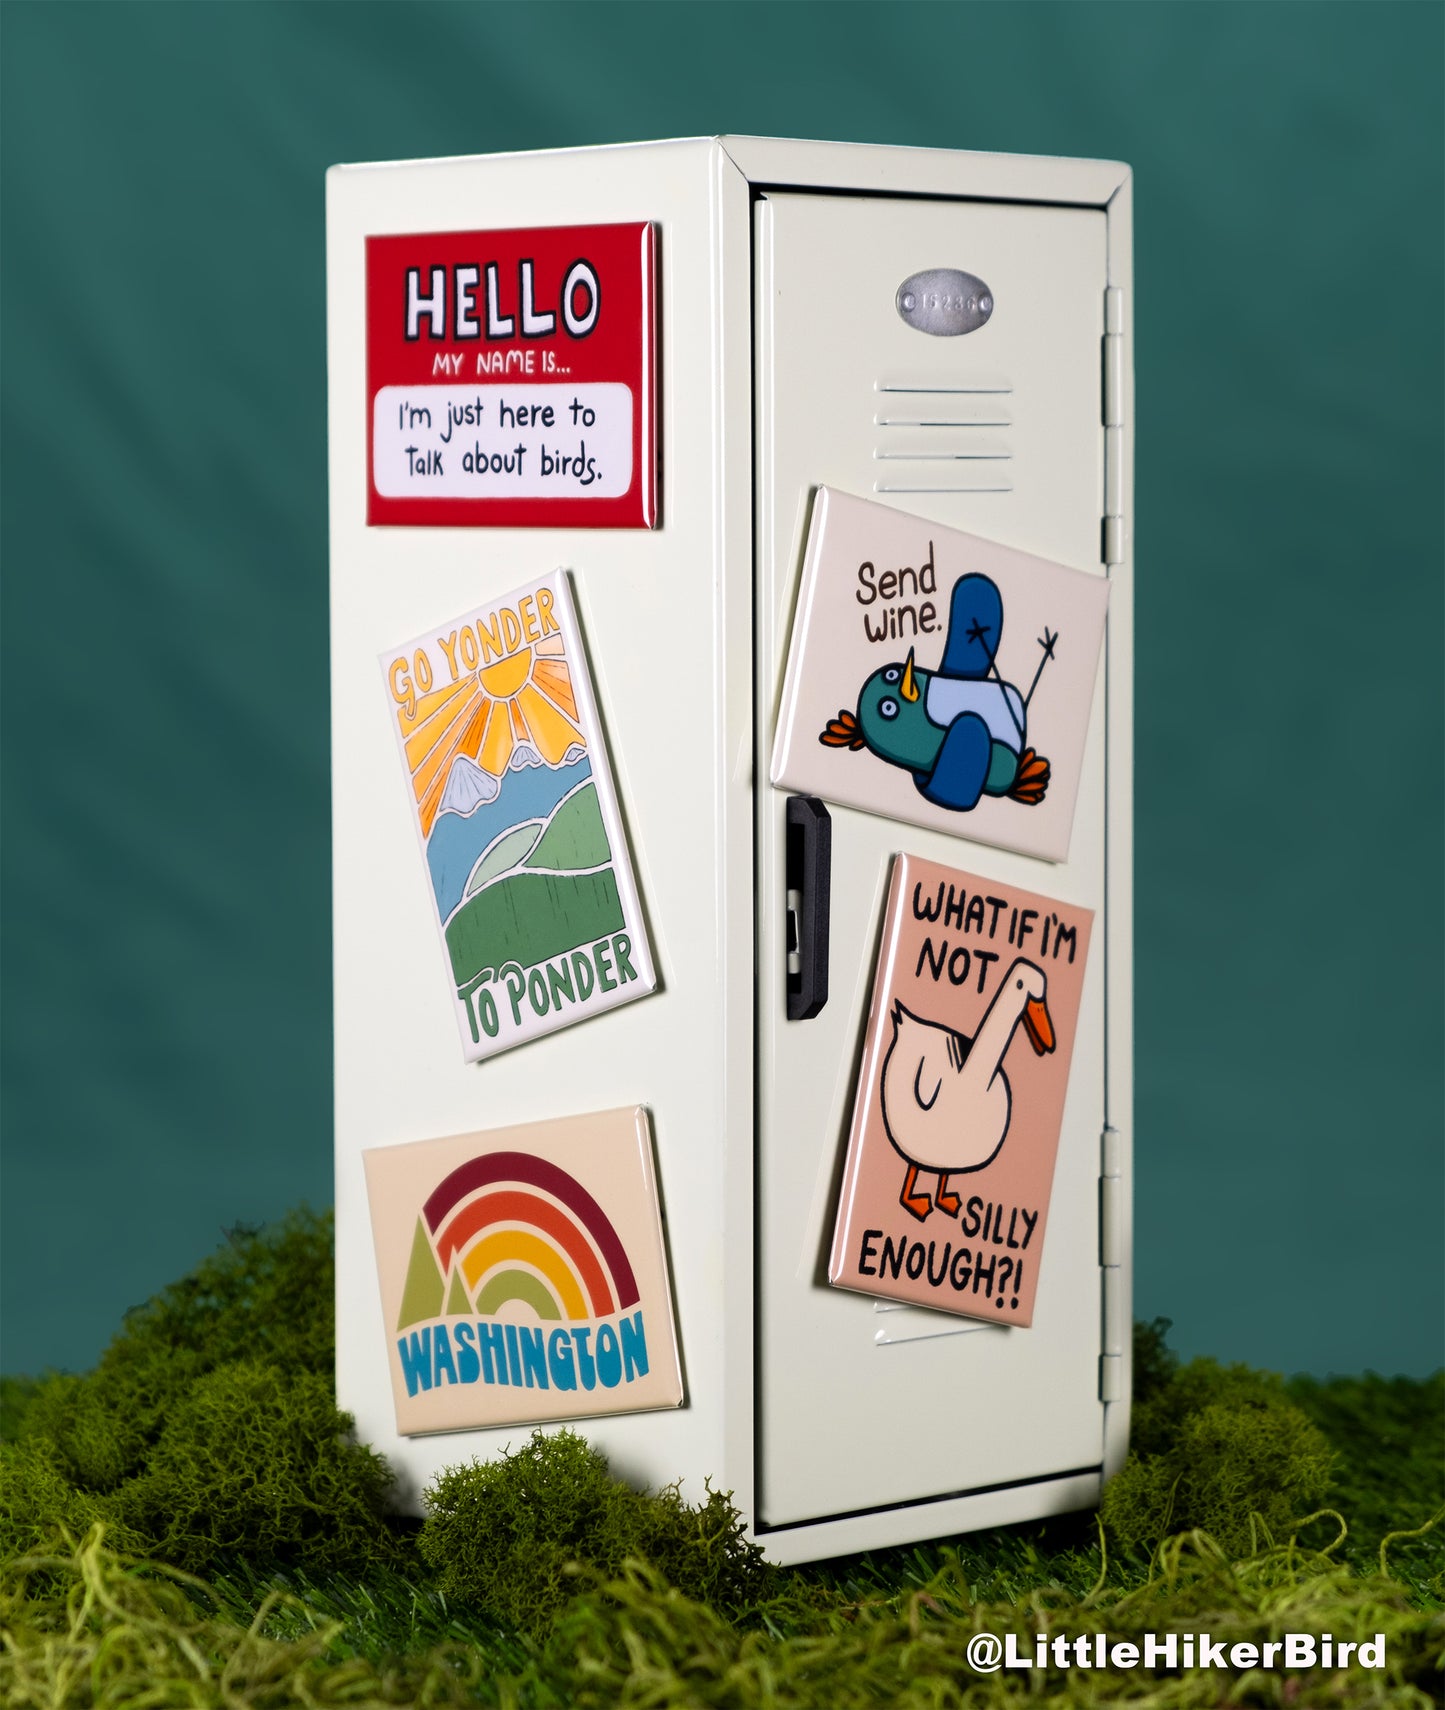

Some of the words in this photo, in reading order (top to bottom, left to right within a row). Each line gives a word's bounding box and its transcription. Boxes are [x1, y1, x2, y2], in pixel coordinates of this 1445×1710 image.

[404, 257, 601, 341] HELLO
[432, 352, 464, 375] MY
[477, 350, 534, 374] NAME
[542, 350, 571, 374] IS...
[399, 401, 431, 430] I'm
[440, 396, 484, 443] just
[500, 398, 555, 428] here
[568, 397, 595, 427] to
[462, 439, 527, 476] about
[541, 439, 602, 486] birds.
[856, 539, 937, 605] Send
[388, 648, 433, 718] GO
[437, 587, 561, 681] YONDER
[864, 601, 942, 643] wine.
[912, 881, 1008, 939] WHAT
[1008, 907, 1039, 949] IF
[1040, 912, 1077, 964] I'M
[457, 970, 499, 1043] TO
[500, 933, 638, 1026] PONDER
[915, 937, 999, 994] NOT
[961, 1196, 1038, 1250] SILLY
[858, 1230, 1022, 1309] ENOUGH?!
[397, 1310, 649, 1398] WASHINGTON
